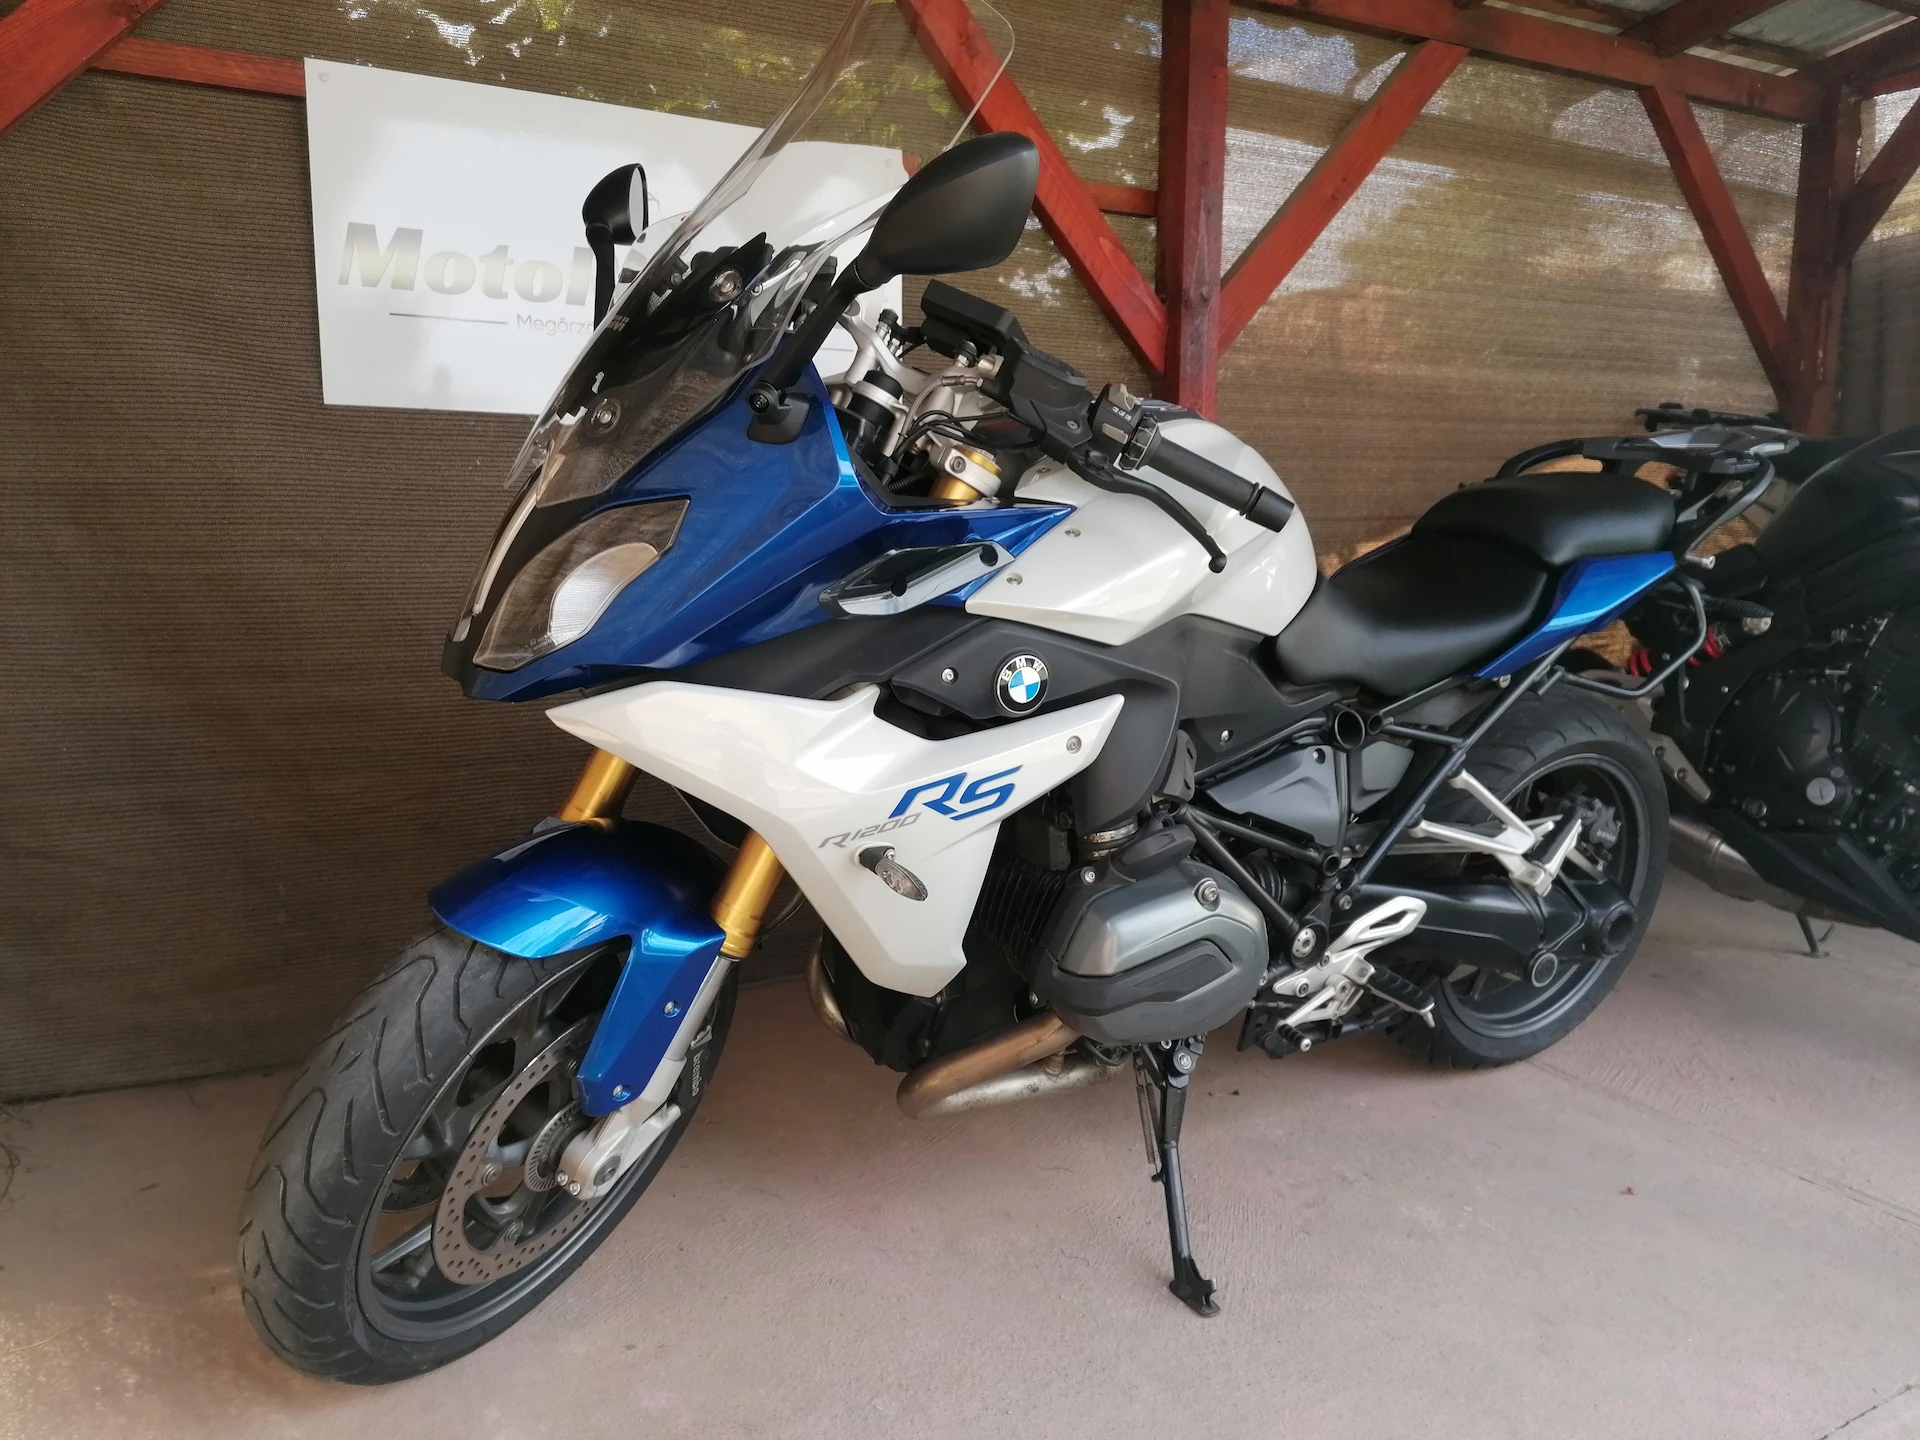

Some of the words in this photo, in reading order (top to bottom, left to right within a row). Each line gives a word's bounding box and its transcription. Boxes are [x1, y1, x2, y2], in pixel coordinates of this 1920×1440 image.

[1001, 657, 1044, 682] BMW
[888, 764, 1023, 822] RS
[817, 811, 922, 849] R1200
[691, 1049, 704, 1097] brembo
